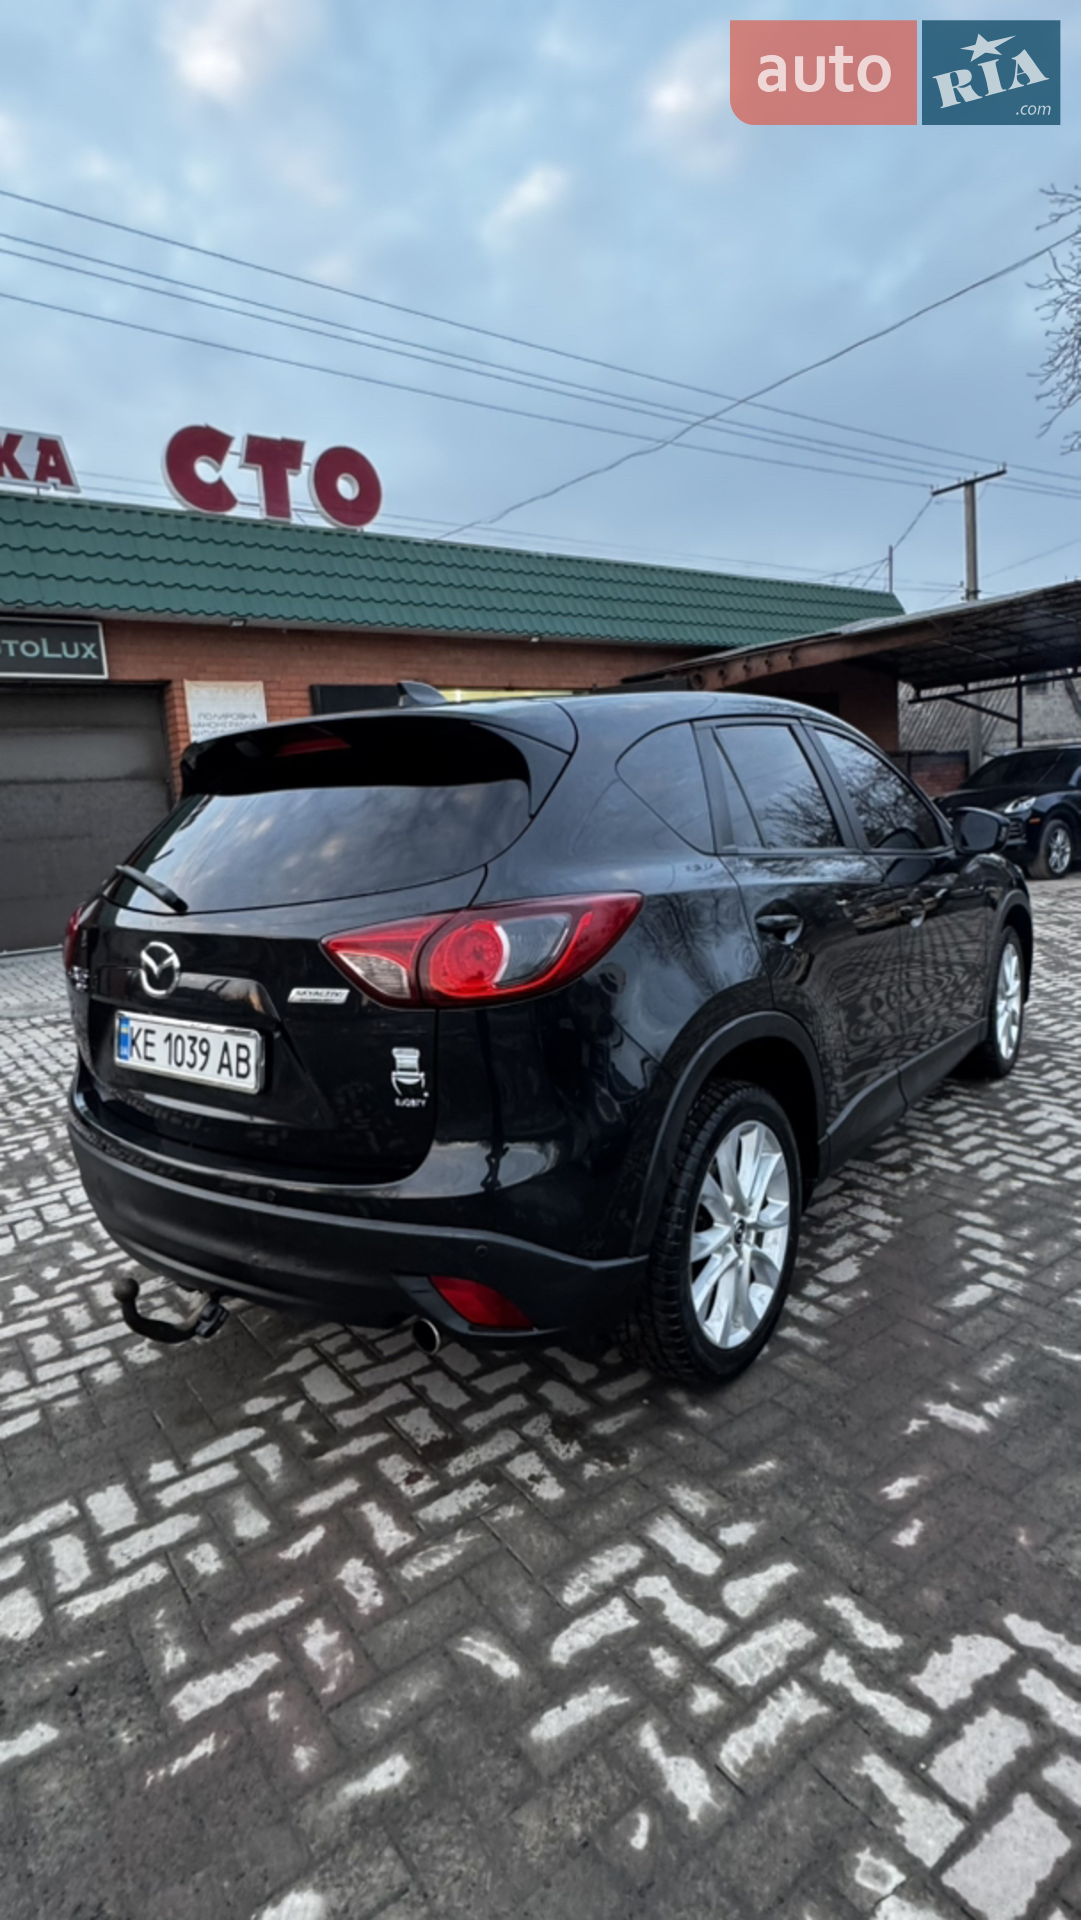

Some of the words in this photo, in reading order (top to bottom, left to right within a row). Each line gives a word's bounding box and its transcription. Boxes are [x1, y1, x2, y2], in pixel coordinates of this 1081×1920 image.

[163, 424, 382, 530] СТО
[131, 1026, 157, 1062] KE
[163, 1032, 211, 1071] 1039
[216, 1041, 251, 1079] AB
